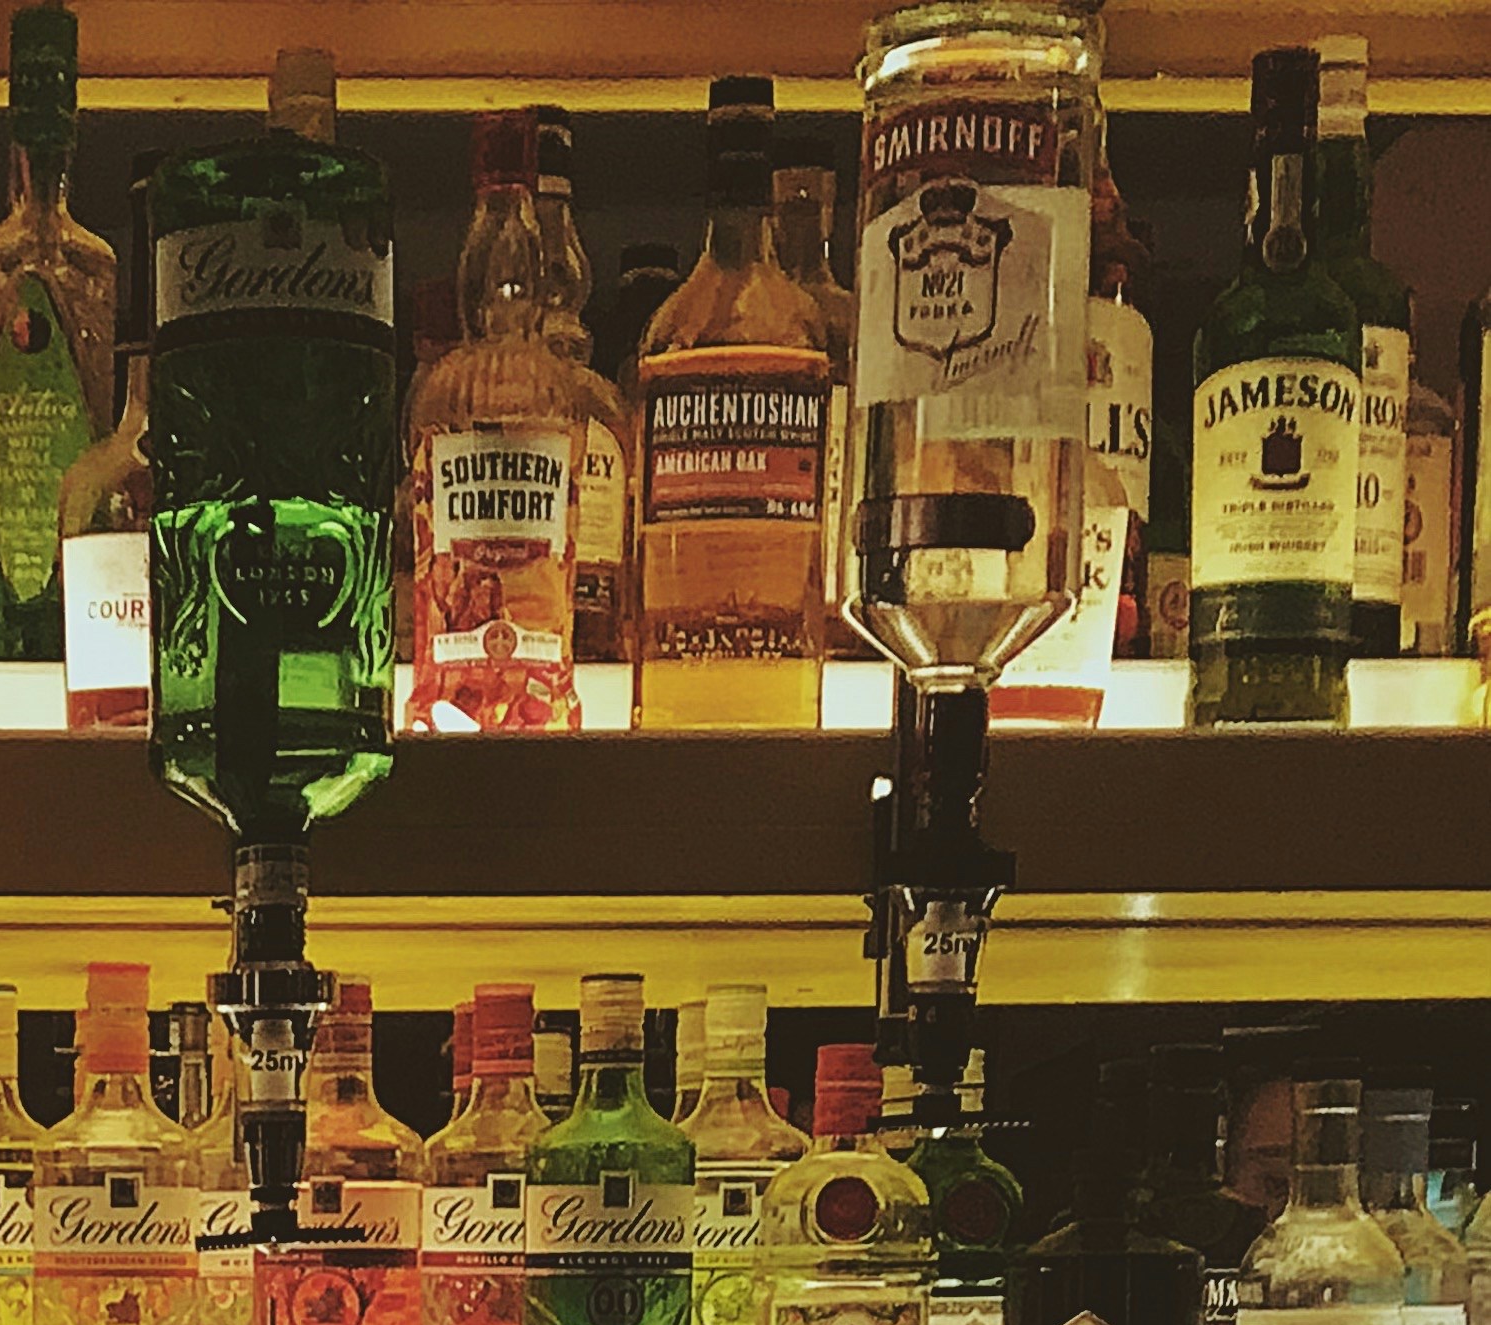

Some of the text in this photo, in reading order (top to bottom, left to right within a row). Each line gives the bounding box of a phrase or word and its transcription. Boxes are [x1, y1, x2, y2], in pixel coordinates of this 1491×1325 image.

[873, 113, 1045, 171] SMIRNOFF
[653, 392, 822, 428] AUCHENTOSHAN
[1204, 373, 1355, 428] JAMESON
[440, 450, 563, 489] SOUTHERN
[655, 450, 767, 475] AMERICAN OAK
[447, 490, 556, 522] COMFORT
[48, 1194, 192, 1246] Gordon's
[540, 1195, 686, 1245] Gordon's
